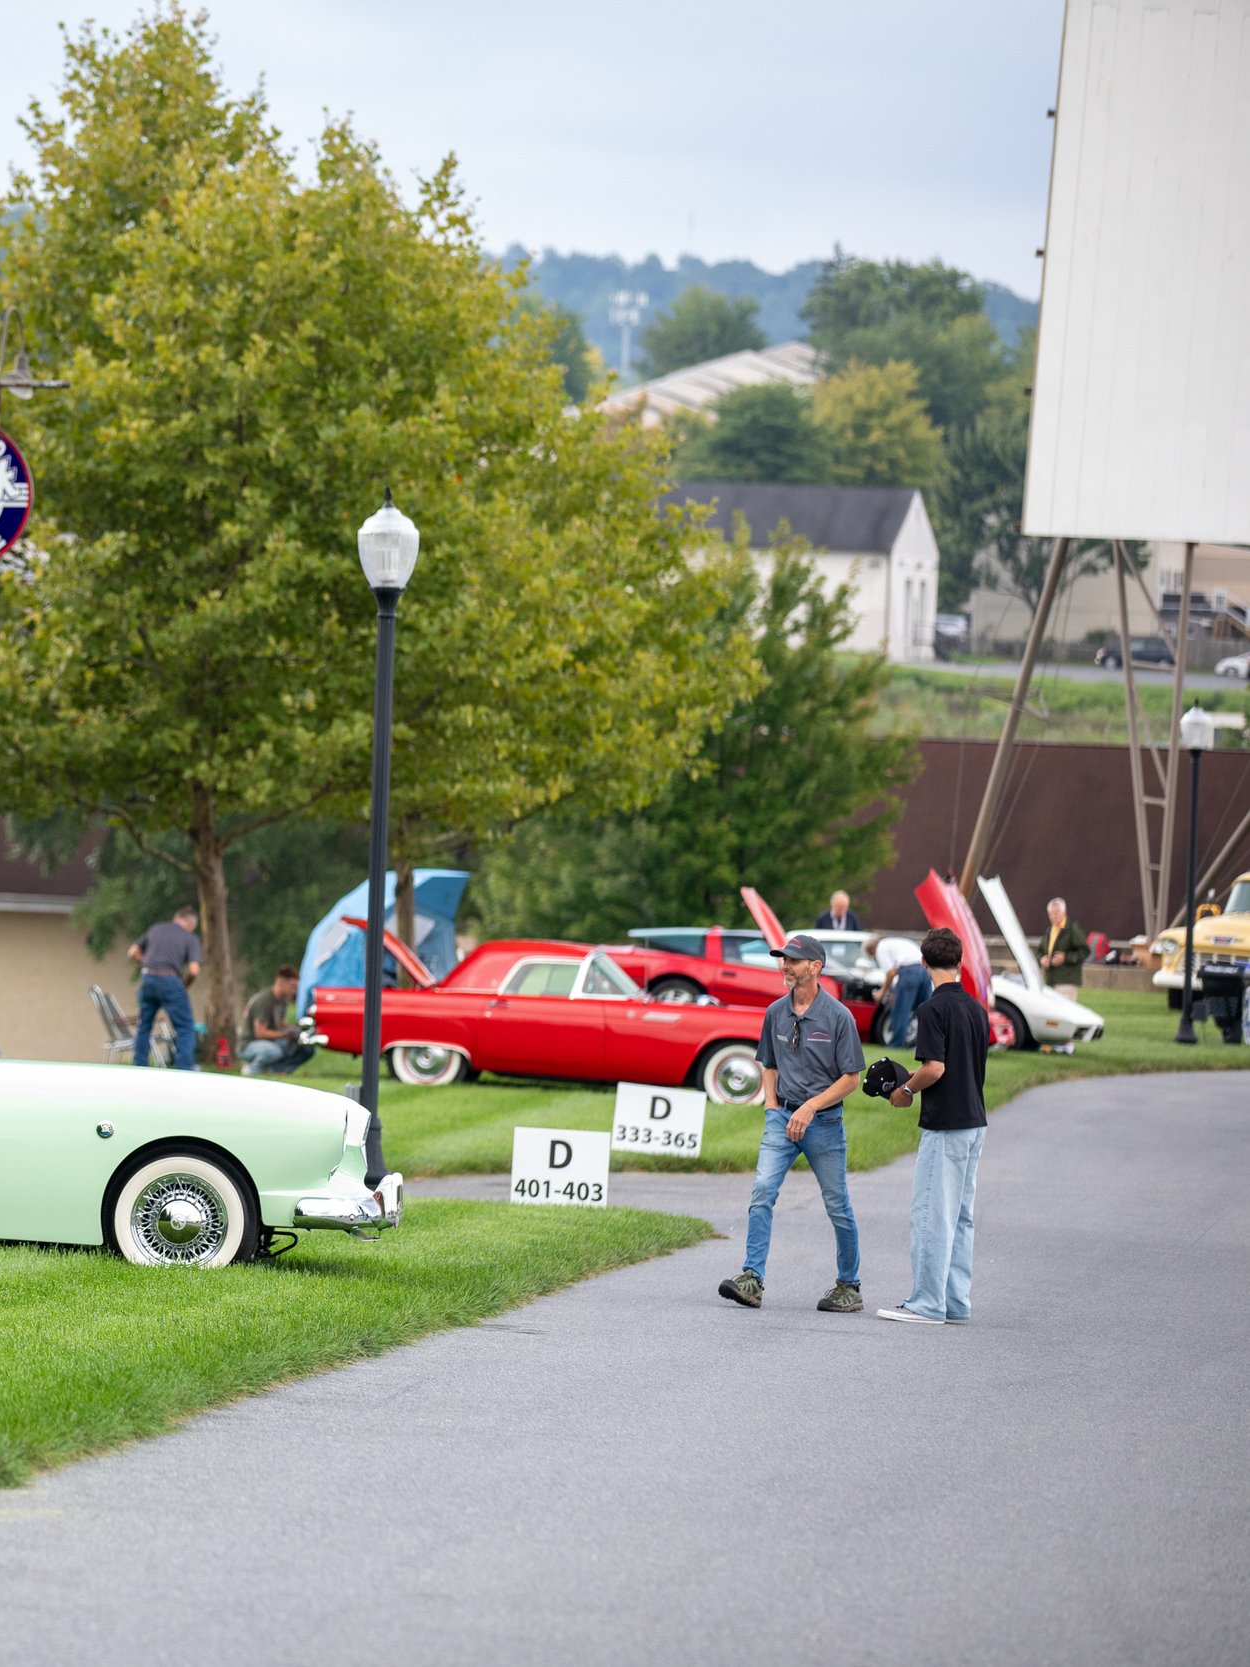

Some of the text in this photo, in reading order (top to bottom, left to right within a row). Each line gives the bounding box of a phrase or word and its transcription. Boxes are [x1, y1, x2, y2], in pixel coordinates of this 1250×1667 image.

[649, 1096, 671, 1120] D
[616, 1125, 698, 1149] 333-365
[549, 1140, 573, 1169] D
[514, 1179, 603, 1201] 401-403
